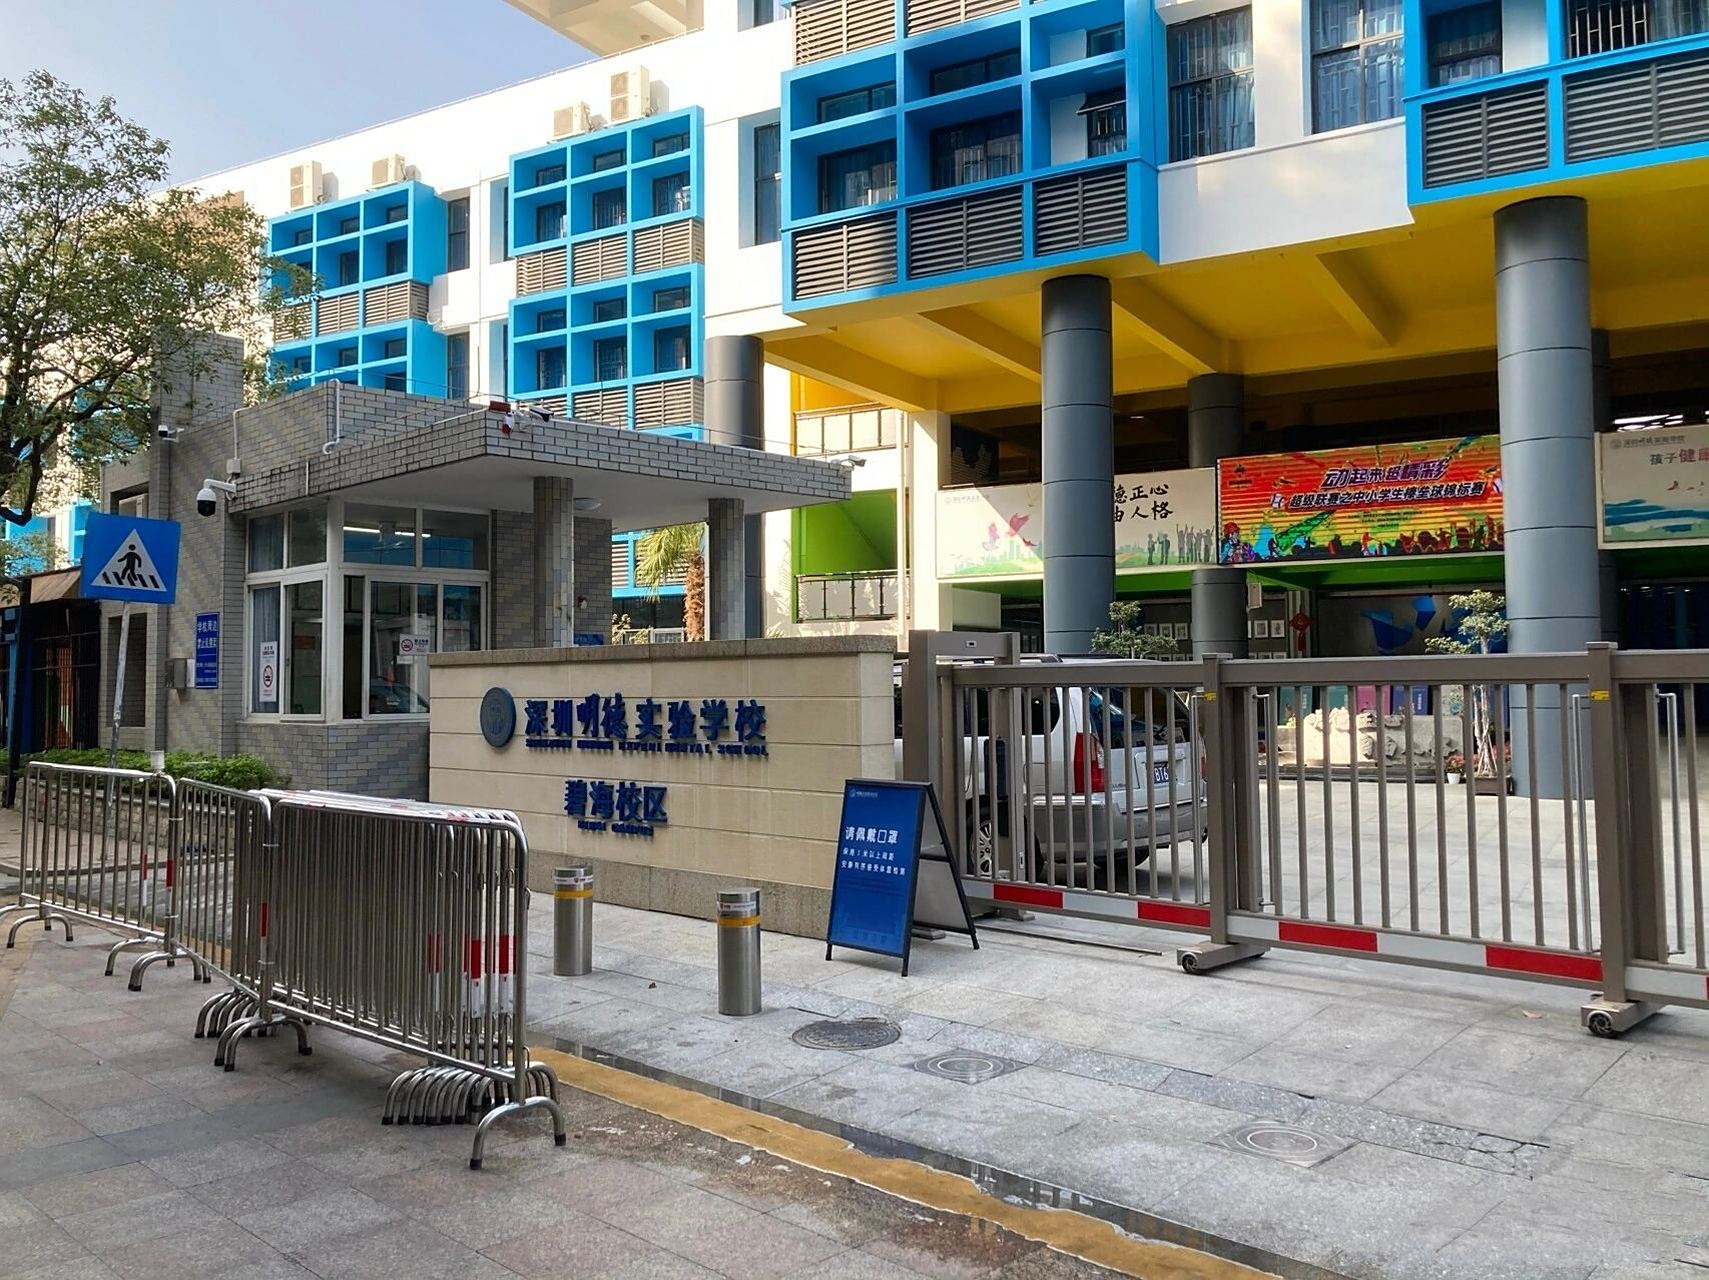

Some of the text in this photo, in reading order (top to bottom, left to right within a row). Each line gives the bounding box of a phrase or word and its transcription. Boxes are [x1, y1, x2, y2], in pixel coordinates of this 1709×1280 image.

[564, 779, 668, 824] 碧海校区
[845, 826, 898, 844] 请佩戴口罩
